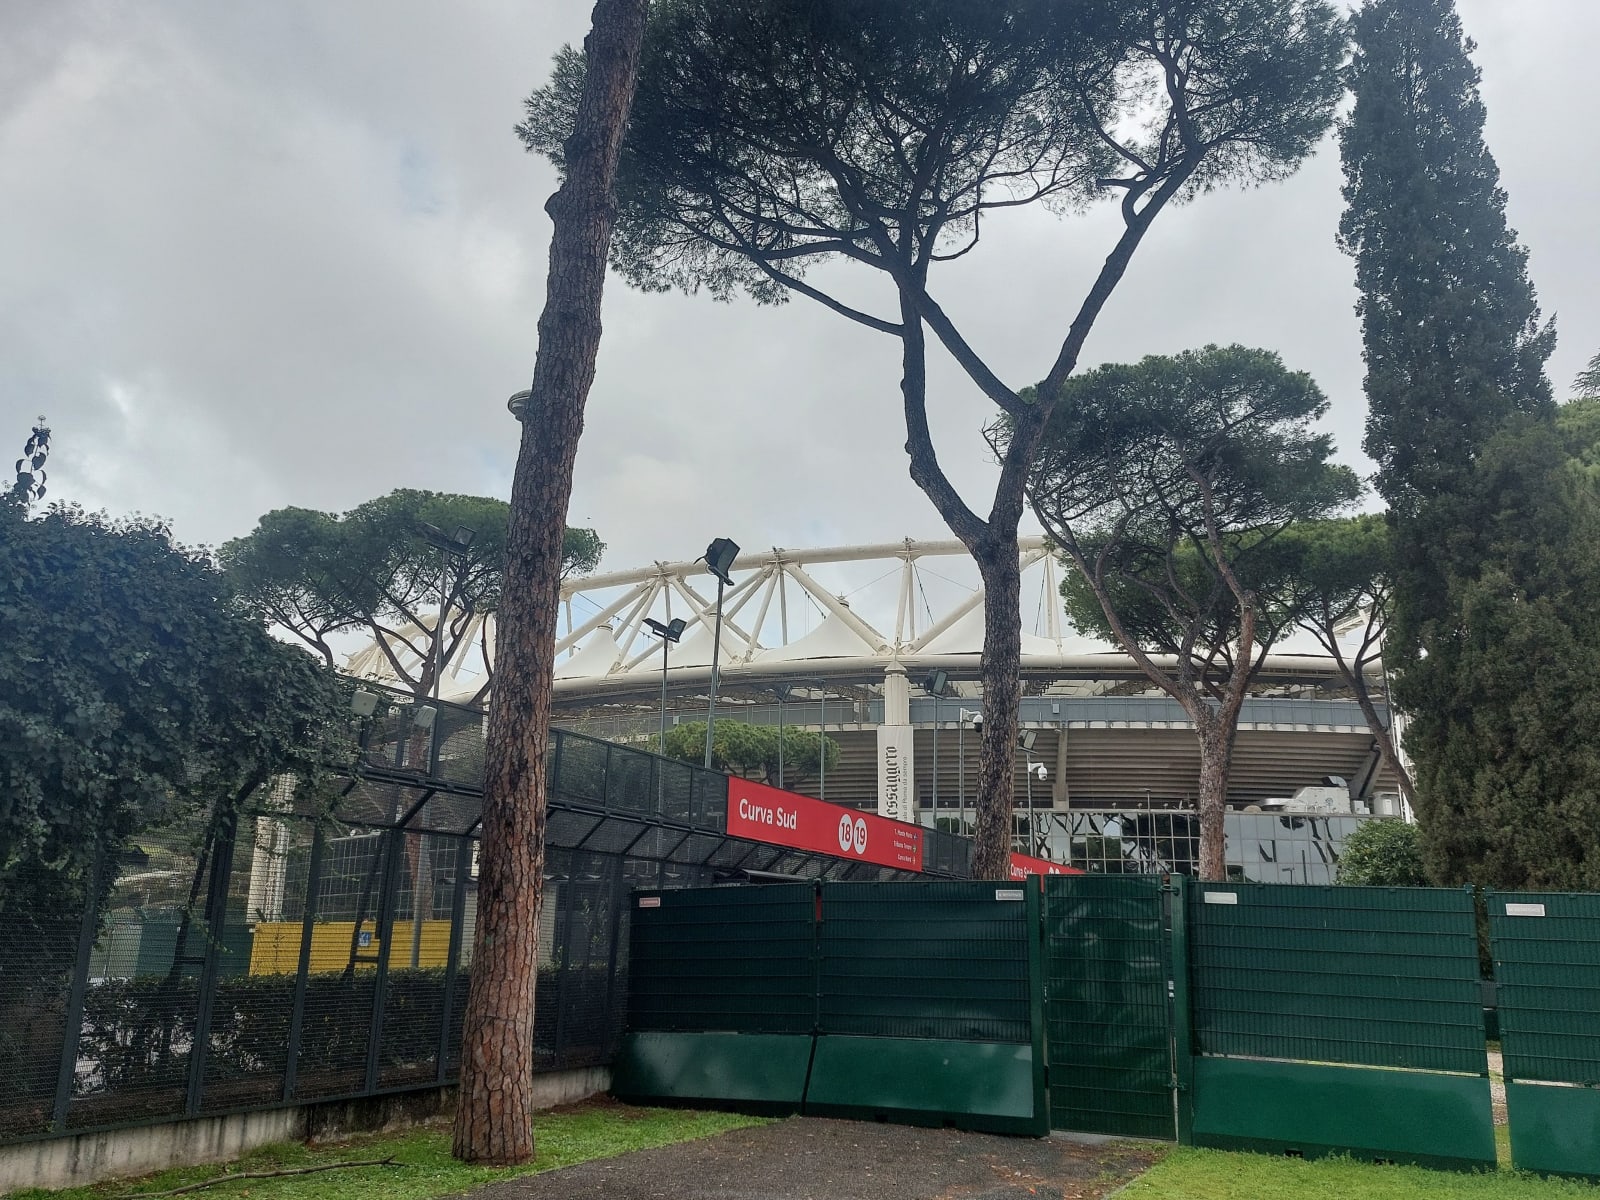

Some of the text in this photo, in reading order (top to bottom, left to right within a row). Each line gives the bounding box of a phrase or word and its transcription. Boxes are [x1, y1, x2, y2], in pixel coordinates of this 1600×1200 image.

[886, 746, 900, 819] essaggero
[740, 798, 797, 830] Curva Sud
[841, 822, 866, 846] 18 19
[1010, 863, 1023, 878] Curva
